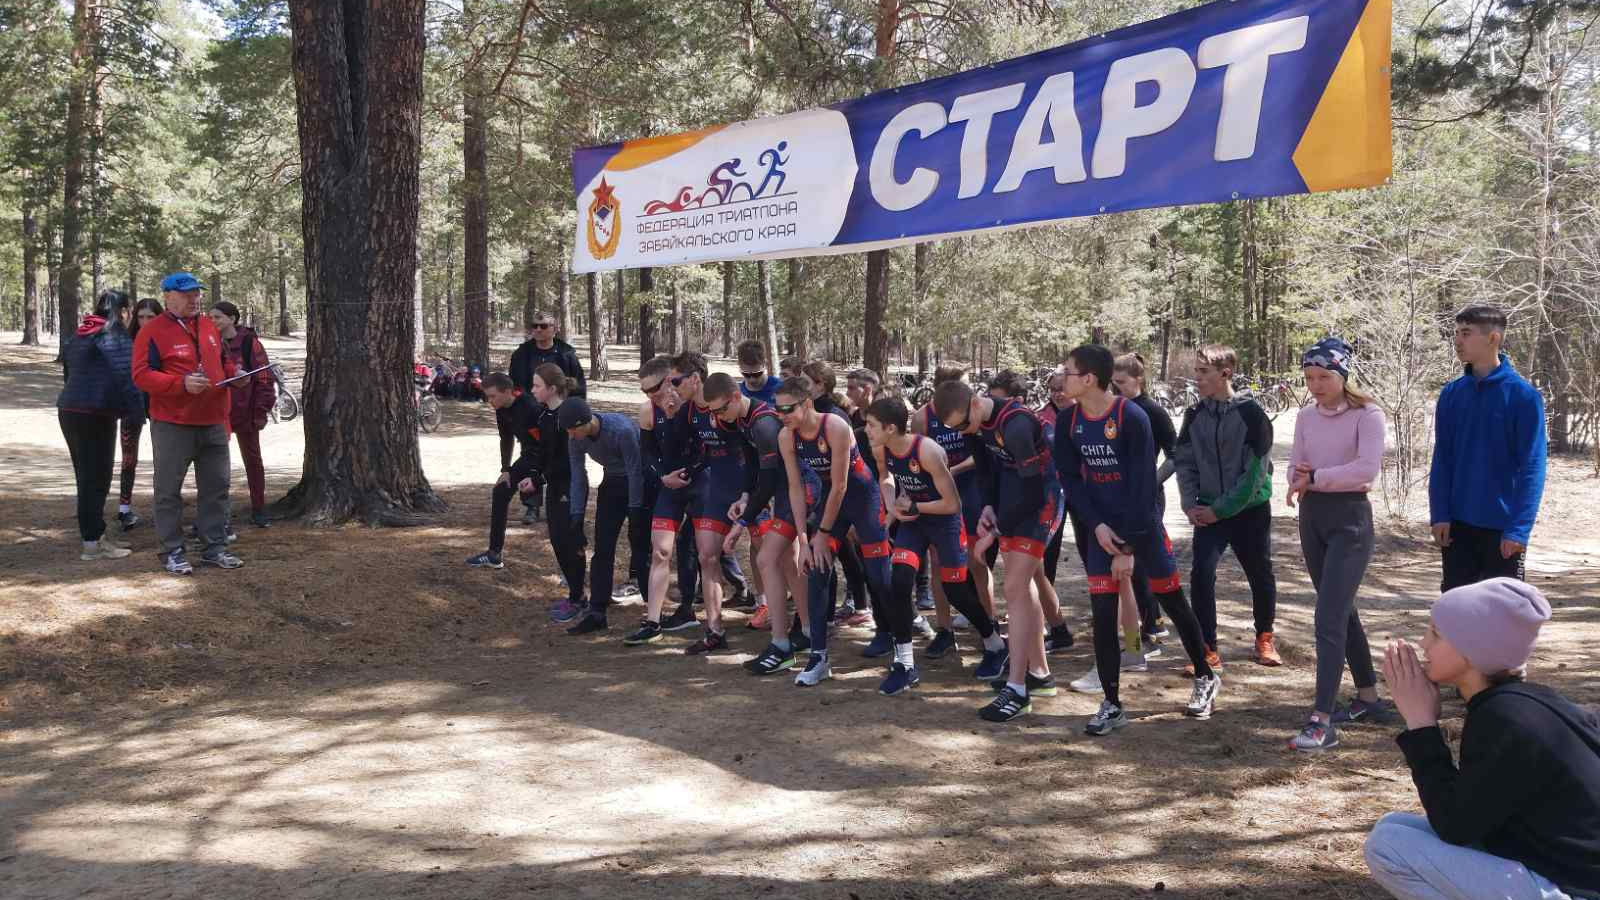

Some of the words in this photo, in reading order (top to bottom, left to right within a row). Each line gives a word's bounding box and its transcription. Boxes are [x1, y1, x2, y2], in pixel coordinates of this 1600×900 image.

[869, 15, 1309, 211] СТАРТ
[636, 213, 714, 234] ФЕДЕРАЦИЯ
[718, 201, 798, 225] ТРИАТЛОНА
[639, 228, 754, 253] ЗАБАЙКАЛЬСКОГО
[758, 223, 796, 239] КРАЯ
[936, 431, 963, 443] CHITA
[1081, 444, 1115, 456] CHITA
[894, 473, 922, 485] CHITA
